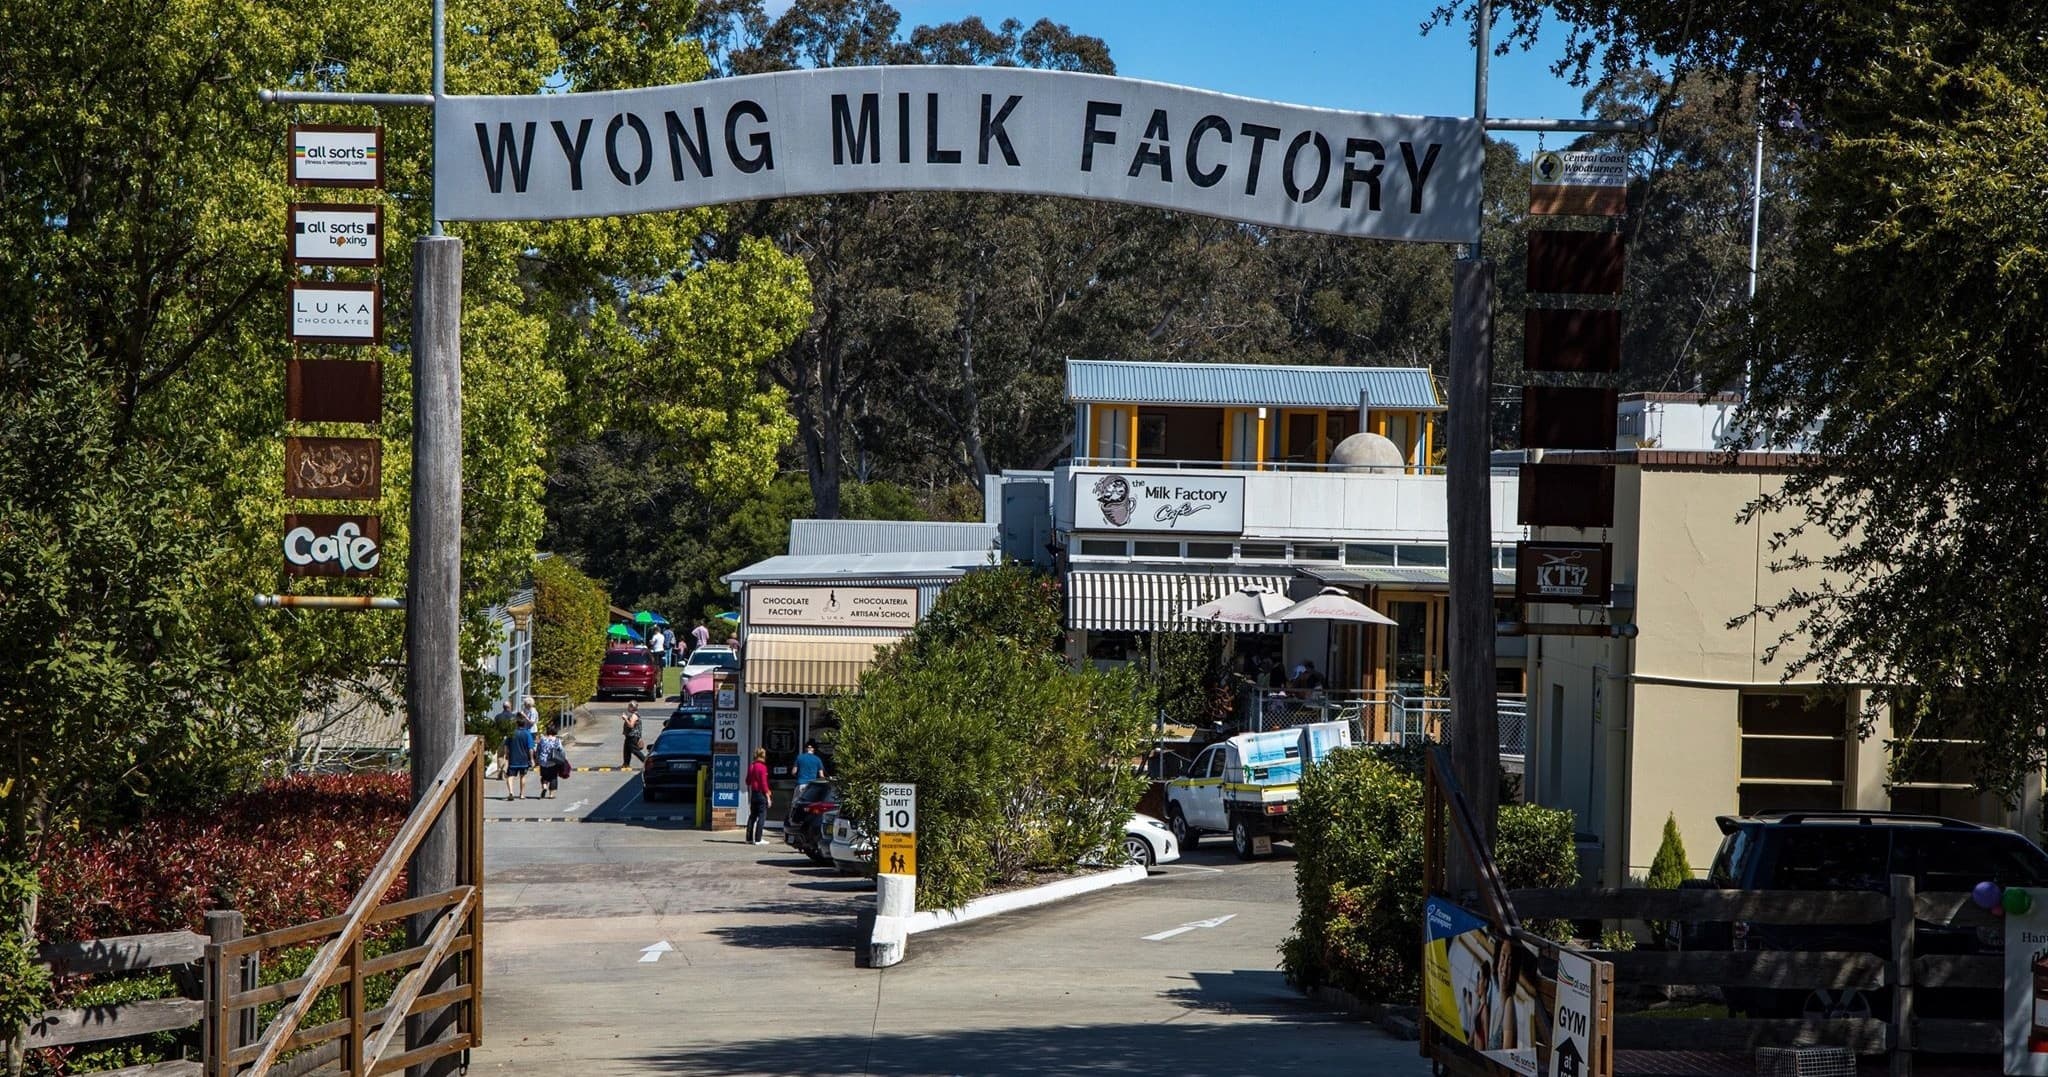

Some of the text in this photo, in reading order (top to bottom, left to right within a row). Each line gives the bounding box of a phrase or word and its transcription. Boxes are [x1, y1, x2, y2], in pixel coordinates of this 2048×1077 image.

[308, 146, 365, 159] all sorts
[474, 92, 1442, 214] WYONG MILK FACTORY
[1563, 153, 1625, 164] Central Coast
[1564, 162, 1623, 174] Woodturners
[308, 221, 365, 234] all sorts
[297, 302, 370, 314] LUKA
[297, 317, 369, 326] CHOCOLATES
[1132, 479, 1228, 504] the Milk Factory
[284, 522, 380, 572] Cafe
[1536, 565, 1588, 587] KT52
[762, 597, 809, 606] CHOCOLATE
[853, 597, 909, 606] CHOCOLATERIA
[768, 608, 803, 617] FACTORY
[850, 610, 911, 619] ARTISAN SCHOOL
[717, 712, 738, 720] SPEED
[719, 728, 736, 741] 10
[715, 782, 738, 790] SHARED
[882, 787, 913, 796] SPEED
[718, 792, 734, 801] ZONE
[885, 799, 909, 807] LIMIT
[885, 810, 910, 829] 10
[2022, 931, 2048, 944] Han
[1558, 1005, 1587, 1038] GYM
[1563, 1054, 1573, 1071] at
